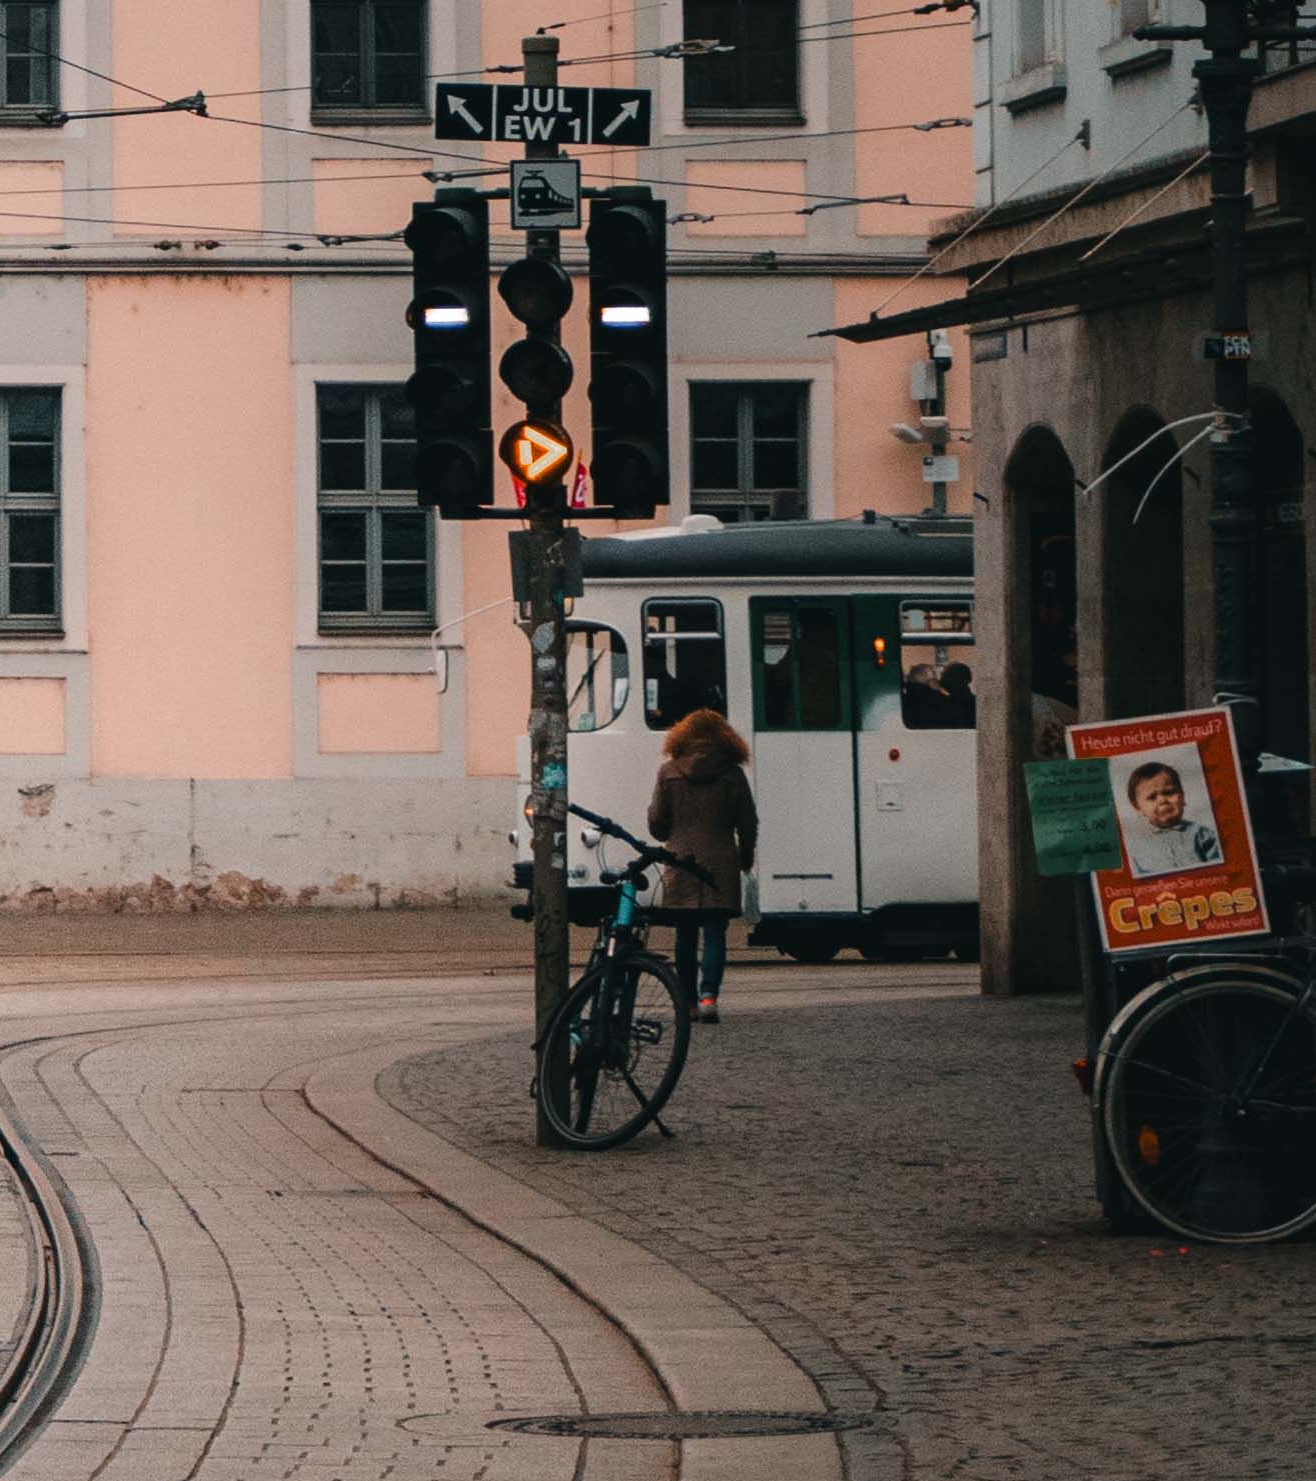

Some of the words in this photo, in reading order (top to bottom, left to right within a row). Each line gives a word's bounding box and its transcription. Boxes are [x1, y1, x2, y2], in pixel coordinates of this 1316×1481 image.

[513, 87, 573, 113] JUL
[504, 114, 556, 141] EW
[567, 117, 582, 143] 1
[1080, 732, 1121, 750] Heute
[1122, 727, 1155, 745] nicht
[1156, 727, 1179, 744] gut
[1180, 718, 1223, 739] drauf?
[1108, 887, 1258, 933] Crêpes
